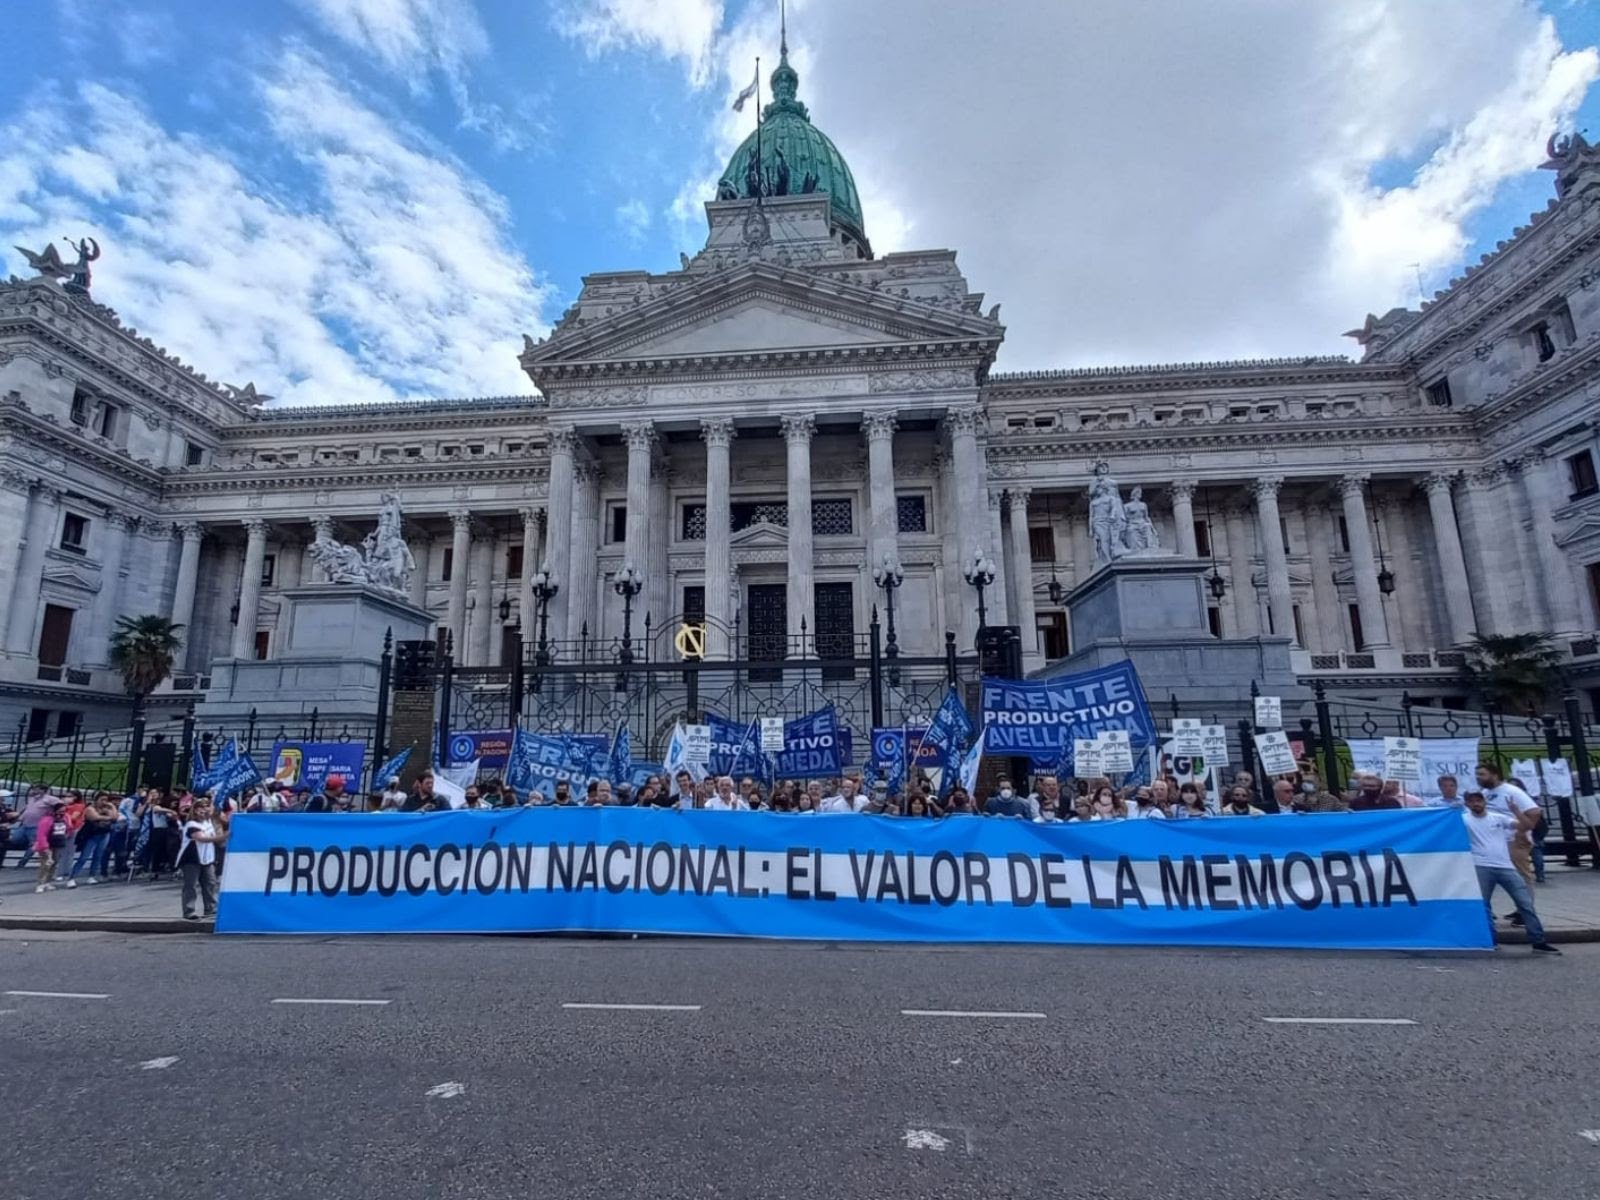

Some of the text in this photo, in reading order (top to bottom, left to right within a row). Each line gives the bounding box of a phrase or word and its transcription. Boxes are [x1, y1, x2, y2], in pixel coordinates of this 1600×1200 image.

[665, 385, 757, 400] CONGRESO
[984, 676, 1130, 711] FRENTE
[984, 700, 1135, 725] PRODUCTIVO
[989, 716, 1144, 748] AVELLANEDA
[266, 827, 1417, 911] PRODUCCIÓN NACIONAL: EL VALOR DE LA MEMORIA
